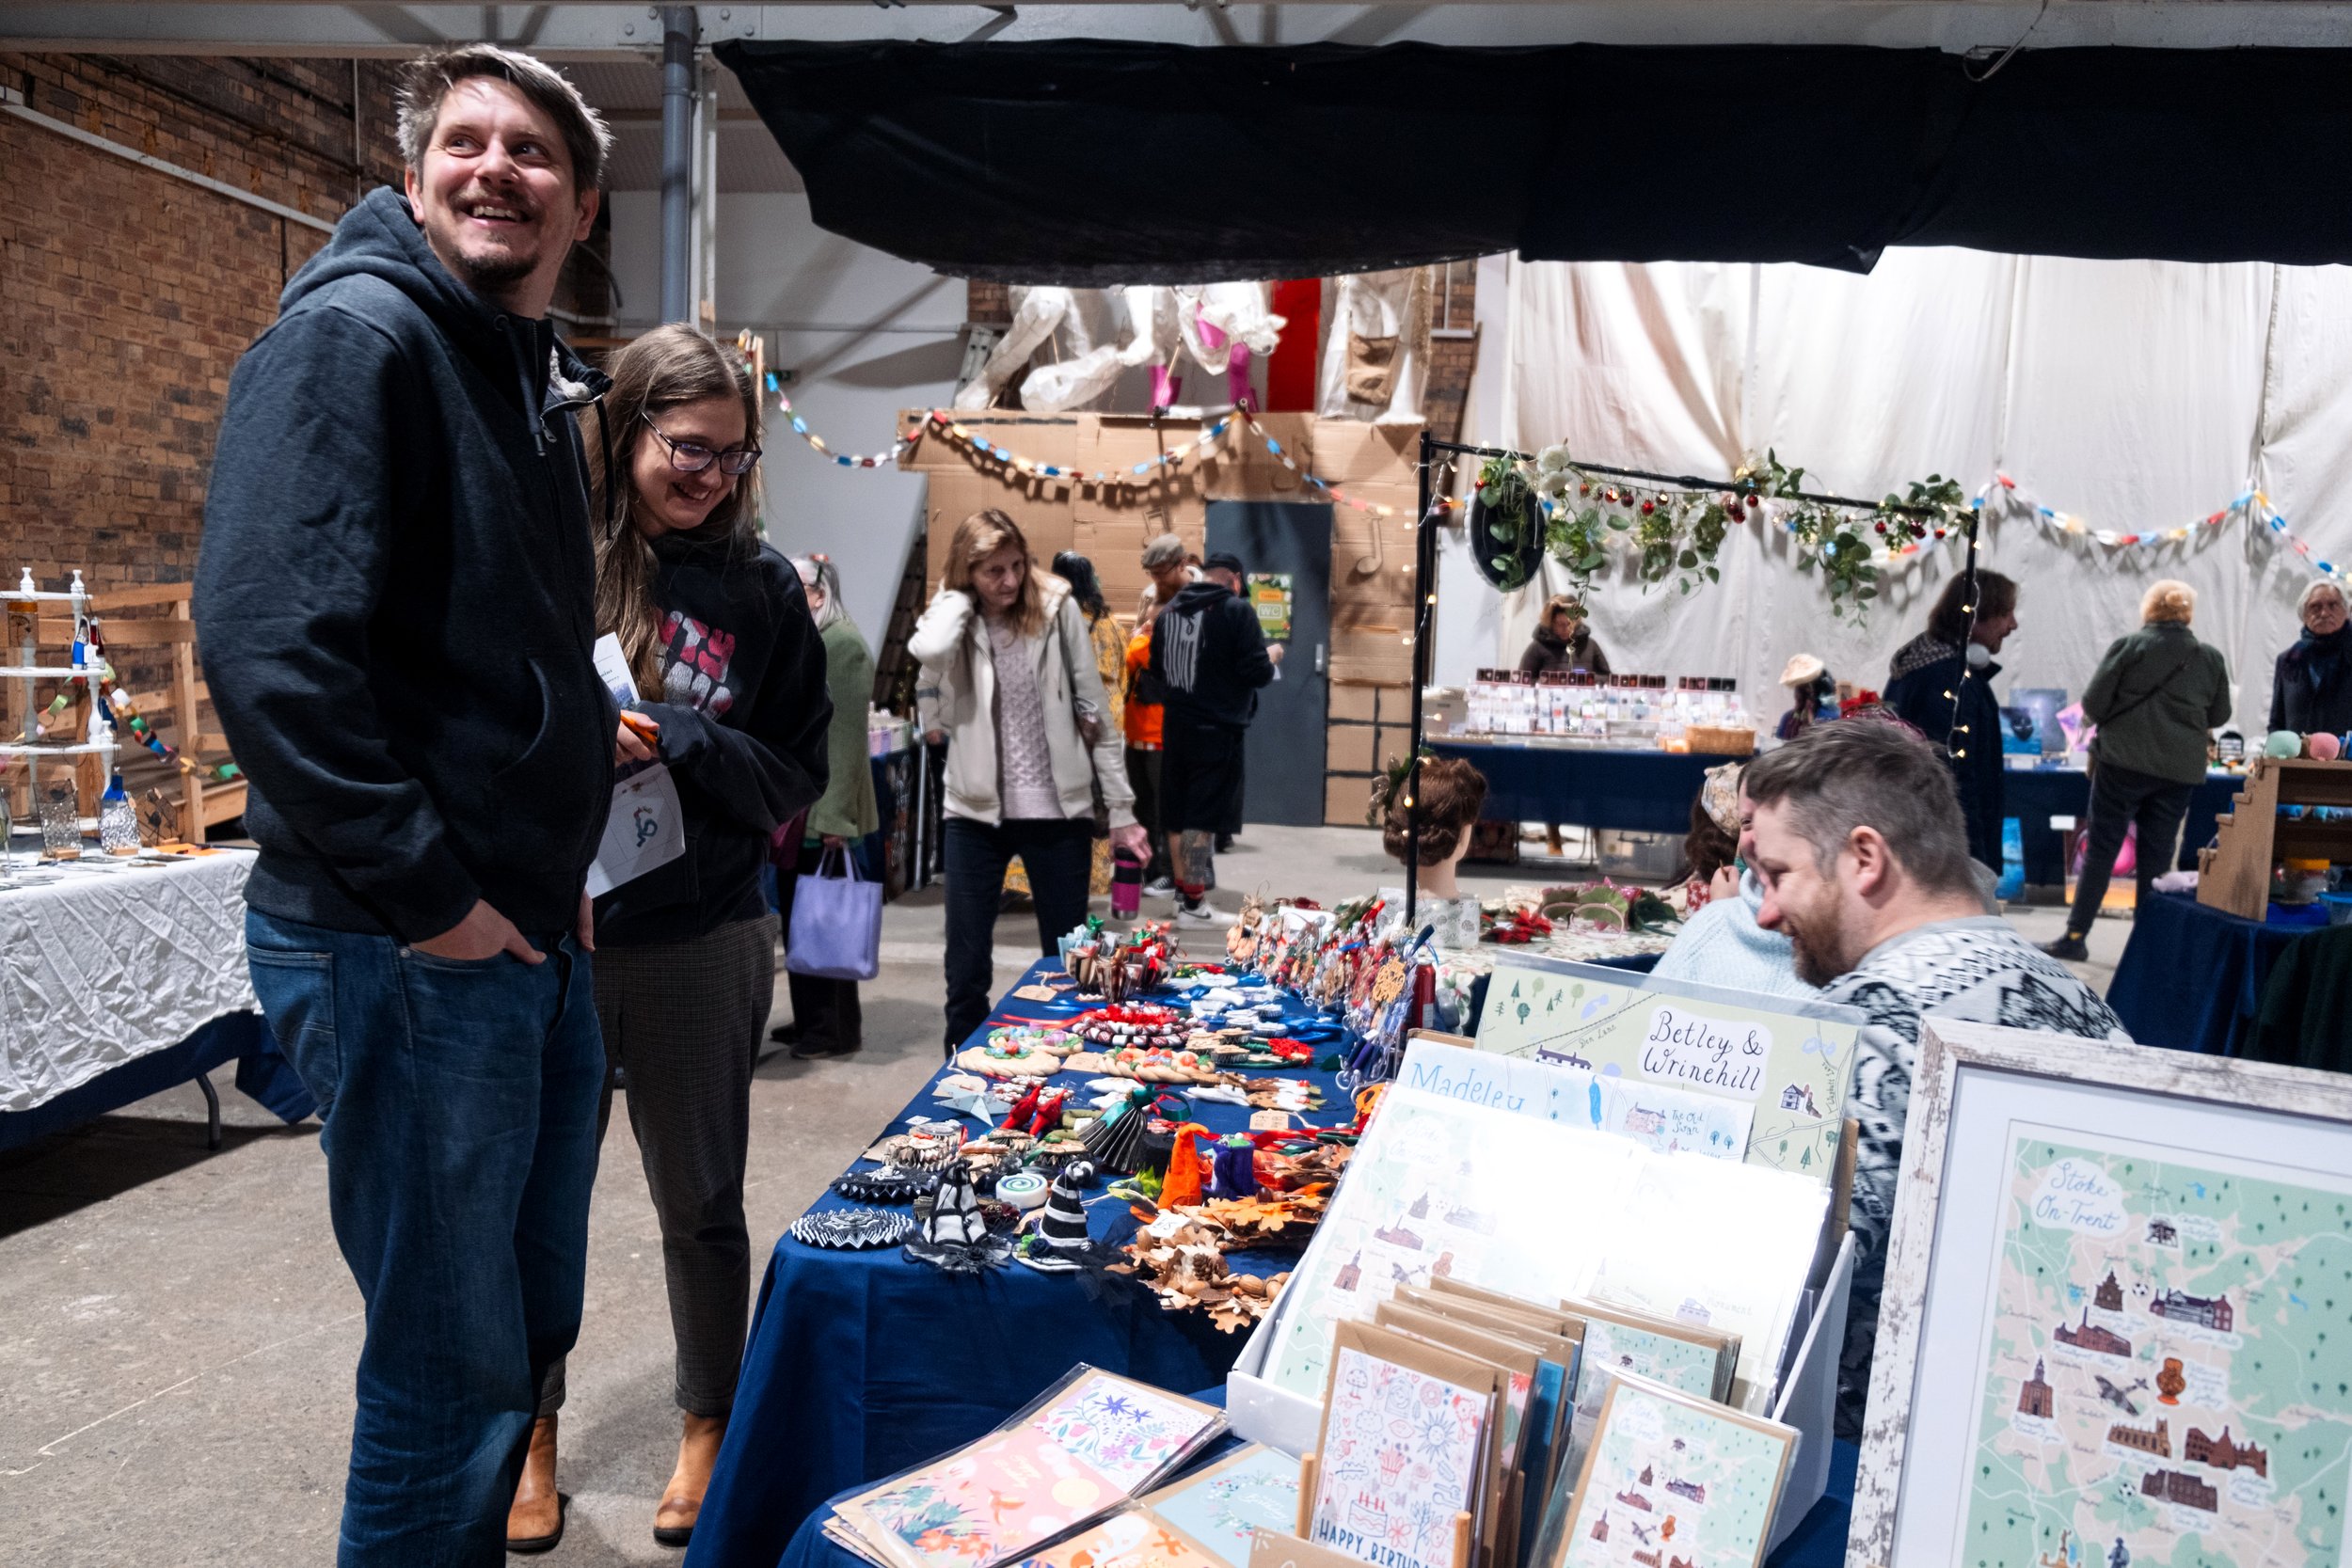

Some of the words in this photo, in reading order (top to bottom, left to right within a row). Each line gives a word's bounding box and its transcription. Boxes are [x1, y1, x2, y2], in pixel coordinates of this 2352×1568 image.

[1260, 606, 1280, 617] WC
[1581, 1036, 1595, 1049] Den
[1597, 1023, 1617, 1039] Lane
[1649, 1009, 1734, 1056] Betley
[1741, 1029, 1764, 1056] &
[1409, 1061, 1525, 1114] Madeley
[1643, 1047, 1762, 1092] Wrinehill
[1671, 1109, 1684, 1121] The
[1672, 1121, 1701, 1137] Swan
[2035, 1194, 2120, 1231] On-Trent
[1318, 1517, 1364, 1555] HAPPY
